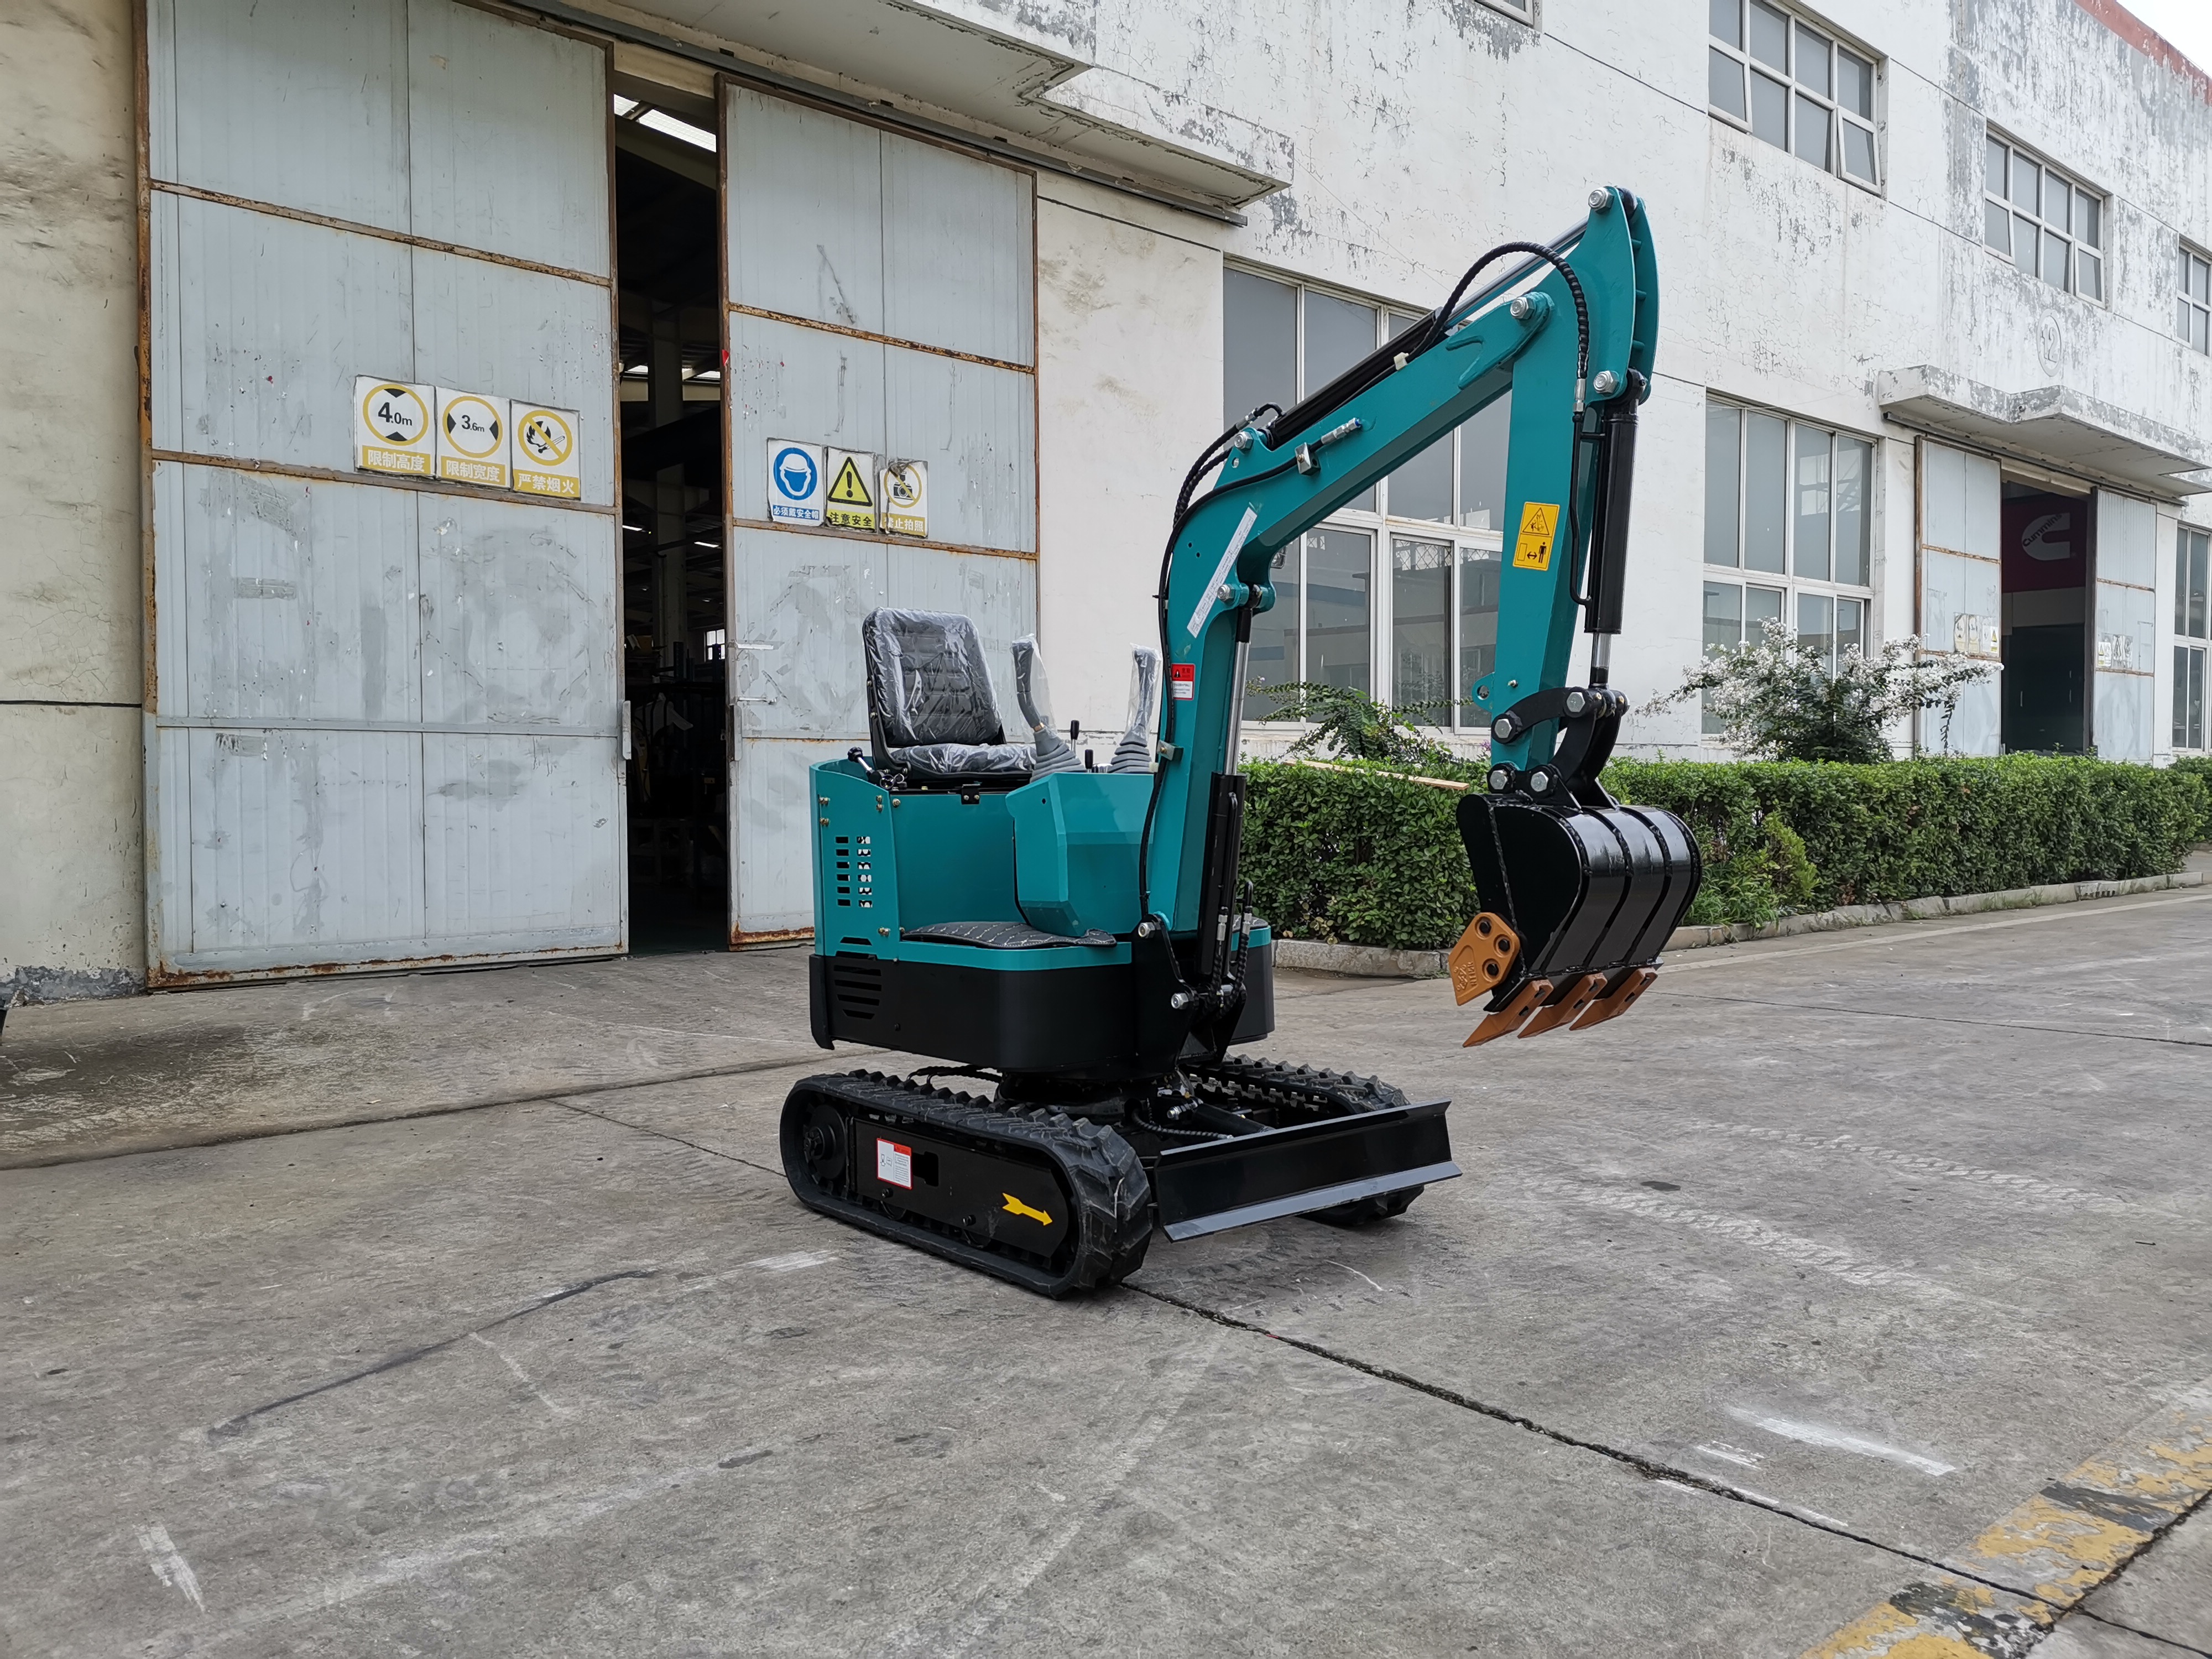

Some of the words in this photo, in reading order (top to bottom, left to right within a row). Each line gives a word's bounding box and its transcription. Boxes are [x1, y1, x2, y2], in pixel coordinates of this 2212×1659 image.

[2041, 324, 2058, 363] 12
[367, 449, 425, 472] 限制高度
[446, 460, 500, 483] 限制宽度
[518, 473, 575, 495] 严禁烟火
[773, 506, 818, 519] 必须戴安全帽
[830, 512, 872, 526] 注意安全
